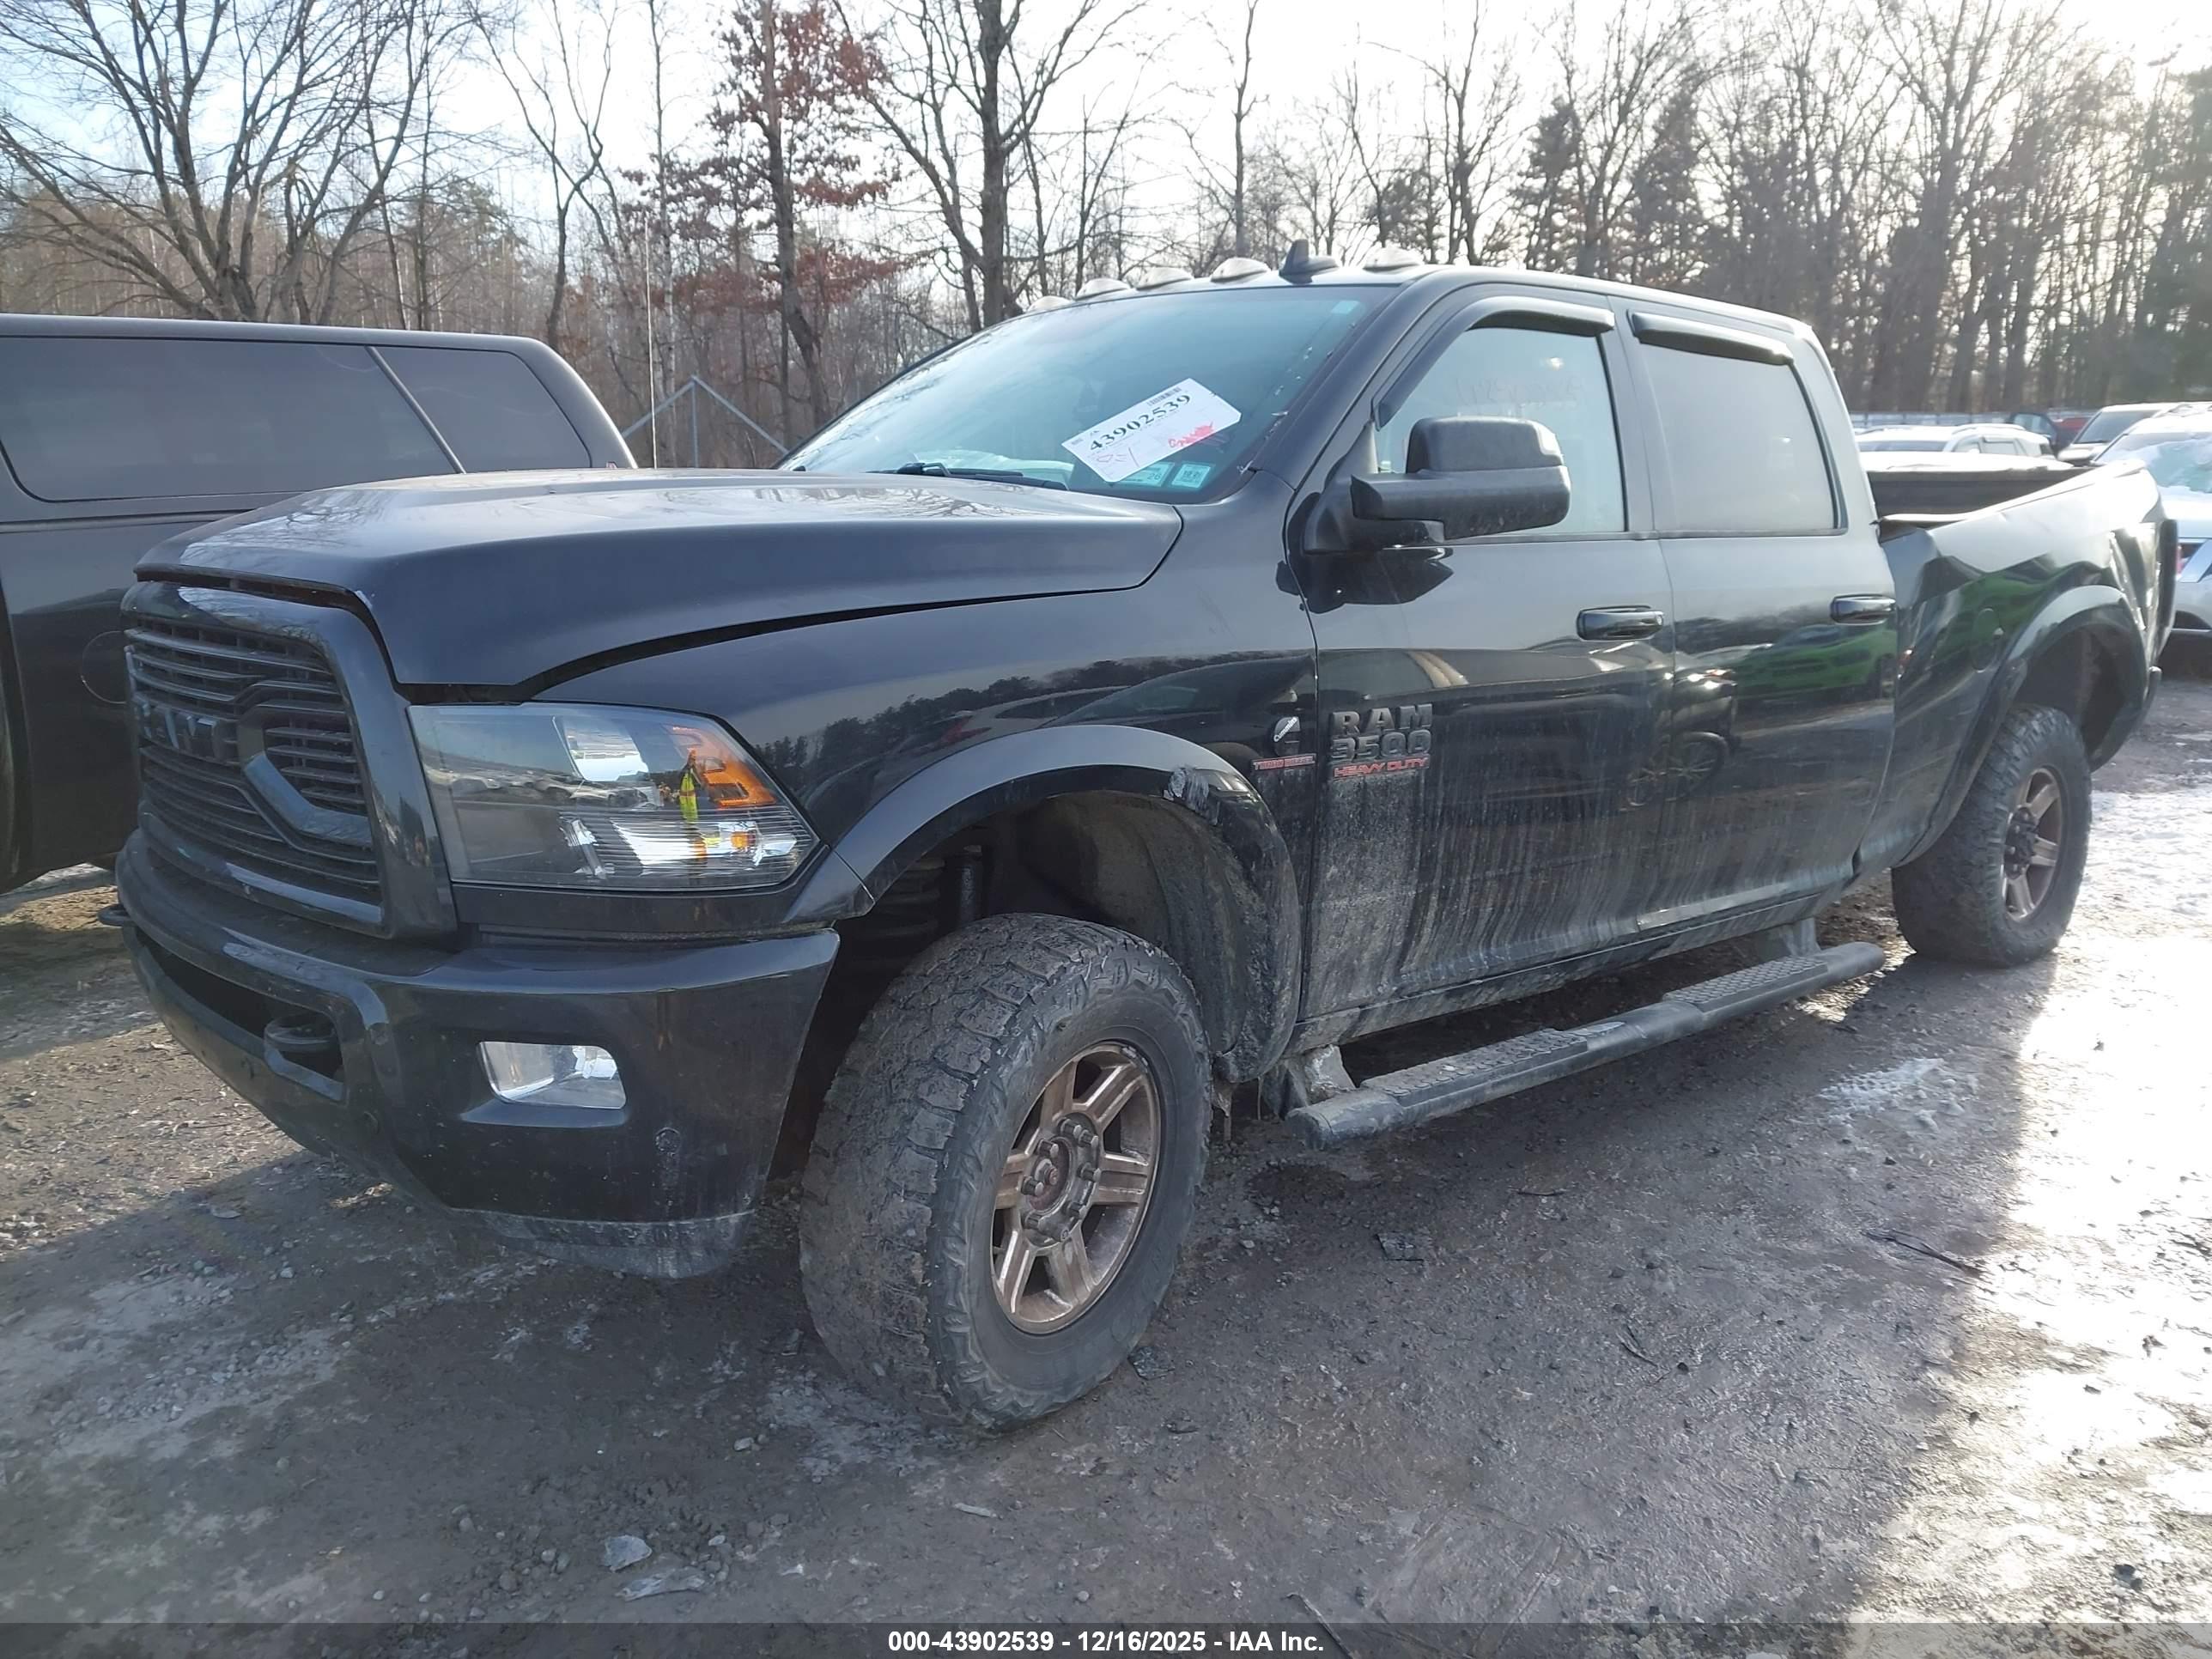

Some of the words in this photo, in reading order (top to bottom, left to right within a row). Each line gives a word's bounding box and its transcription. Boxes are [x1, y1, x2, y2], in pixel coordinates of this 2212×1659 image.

[1089, 393, 1192, 452] 43902539
[1331, 702, 1433, 737] RAM
[1330, 729, 1432, 763] 3500
[1333, 761, 1386, 778] HEAVY
[1387, 757, 1429, 772] DUTY
